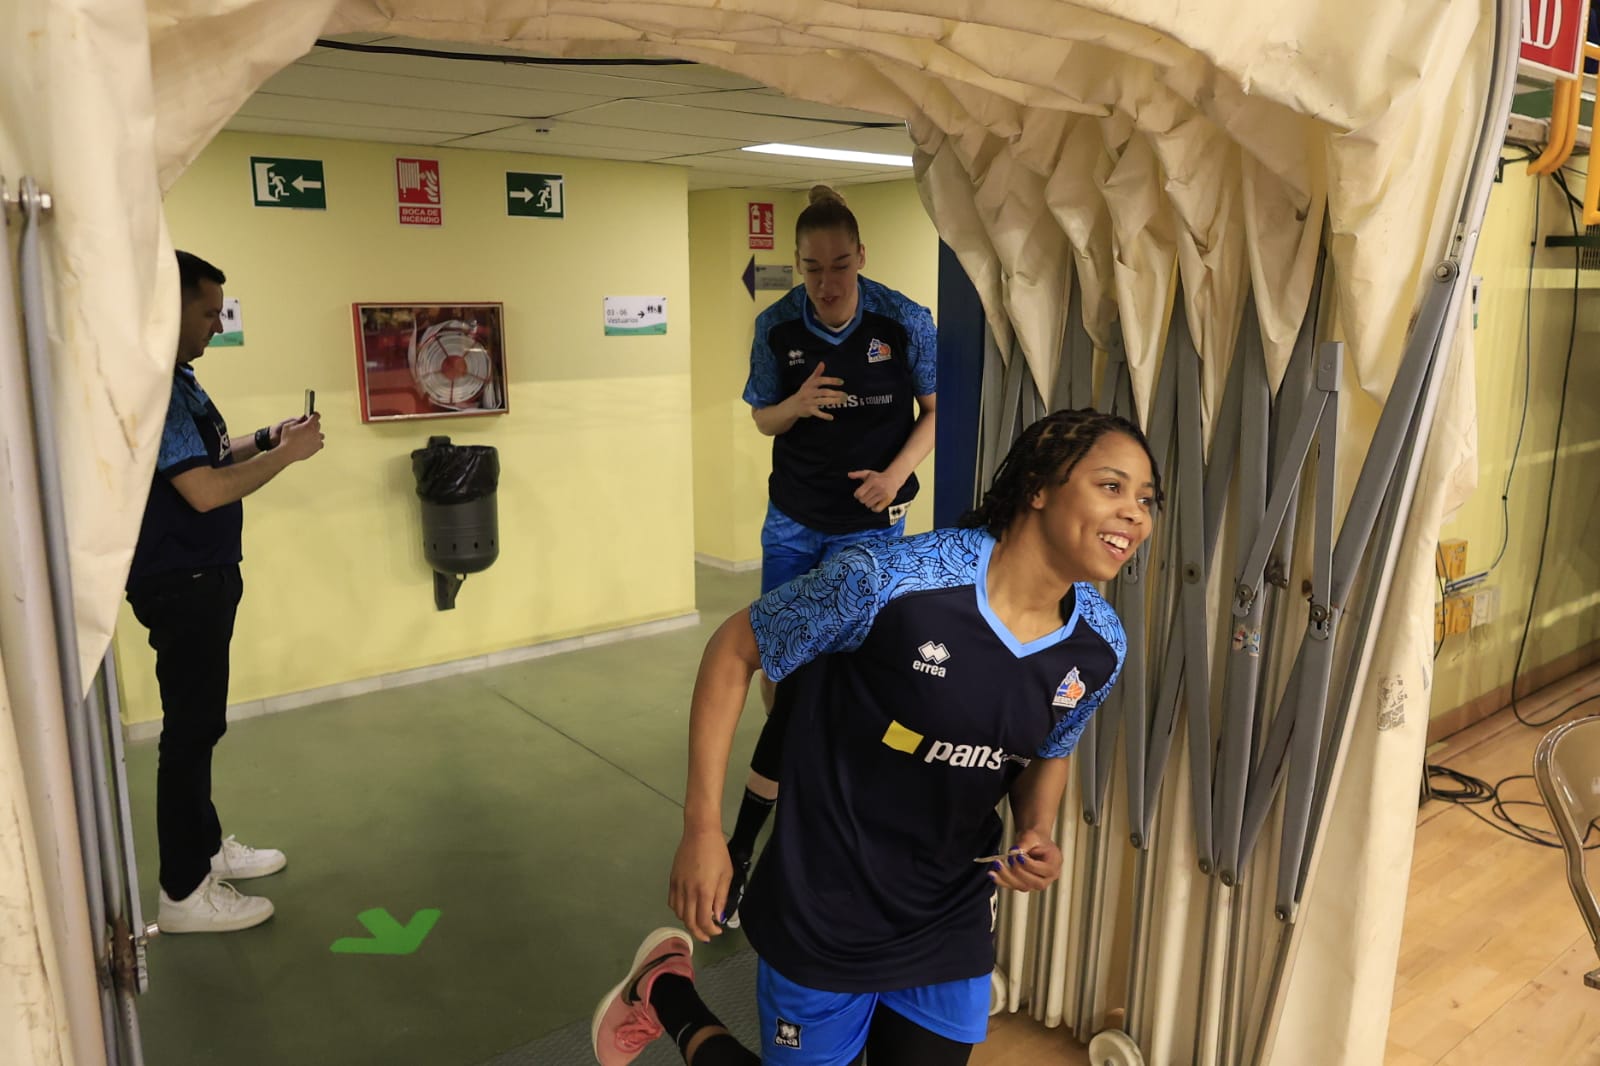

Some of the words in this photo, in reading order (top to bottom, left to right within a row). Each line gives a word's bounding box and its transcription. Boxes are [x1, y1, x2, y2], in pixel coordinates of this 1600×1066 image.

[402, 208, 425, 216] BOCA
[427, 209, 438, 217] DE
[401, 215, 440, 224] INCENDIO
[866, 394, 893, 405] COMPANY
[912, 660, 947, 678] errea
[924, 740, 1003, 770] pans
[775, 1035, 798, 1046] errea
